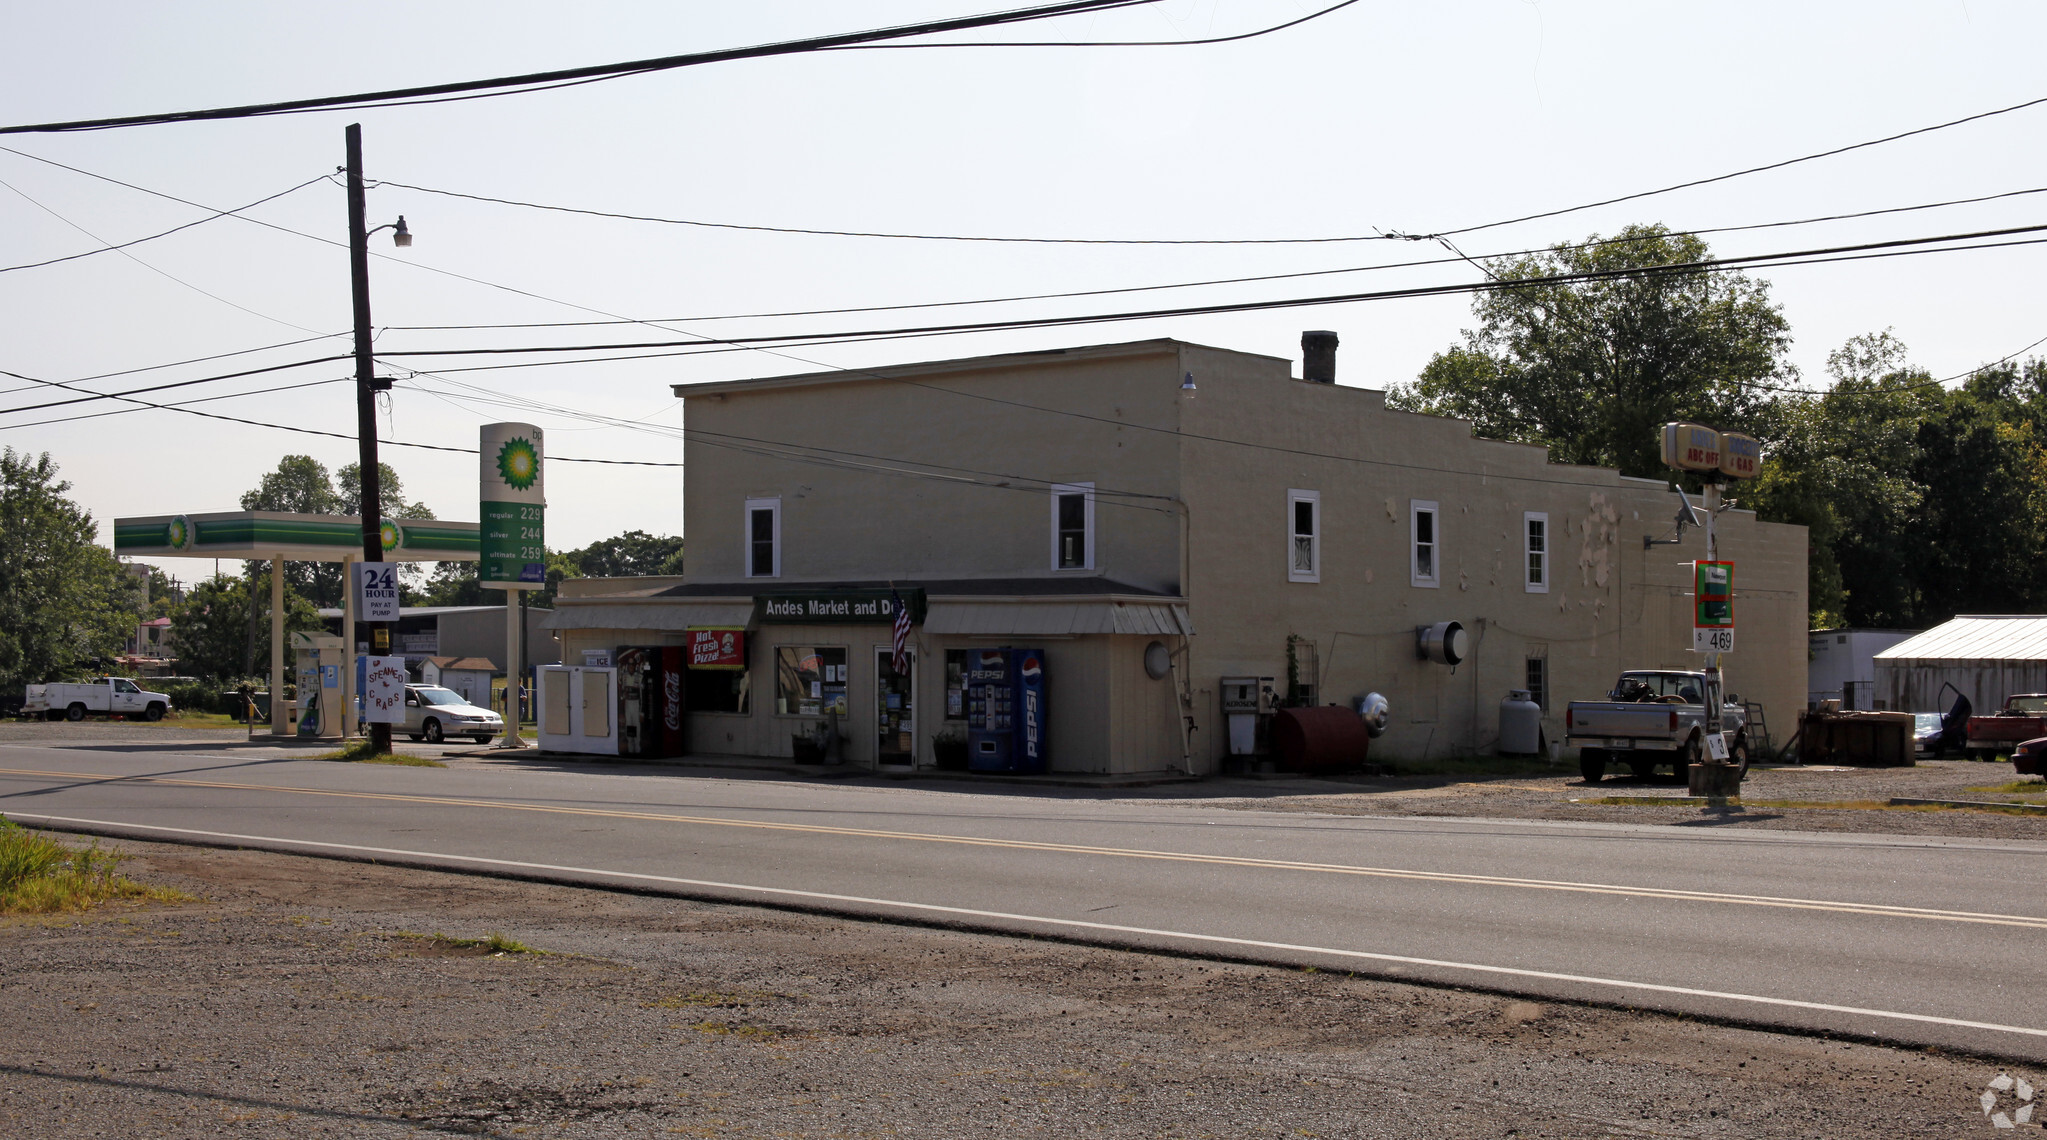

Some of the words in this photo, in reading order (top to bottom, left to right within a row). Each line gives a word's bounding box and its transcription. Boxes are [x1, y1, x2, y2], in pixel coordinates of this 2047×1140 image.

[532, 429, 543, 442] bp
[1687, 447, 1704, 463] ABC
[1705, 451, 1720, 465] OFF
[1736, 456, 1753, 473] GAS
[489, 512, 514, 520] regular
[520, 507, 541, 521] 229
[520, 527, 541, 540] 244
[521, 546, 541, 560] 259
[364, 568, 394, 589] 24
[365, 590, 395, 598] HOUR
[766, 600, 804, 615] Andes
[808, 600, 849, 615] Market
[854, 600, 877, 615] and
[693, 640, 719, 654] Fresh
[597, 657, 608, 666] ICE
[694, 650, 720, 664] Pizza!
[369, 667, 403, 683] STEAMED
[971, 670, 1004, 679] PEPSI
[369, 690, 399, 710] CRABS
[1026, 689, 1038, 758] PEPSI
